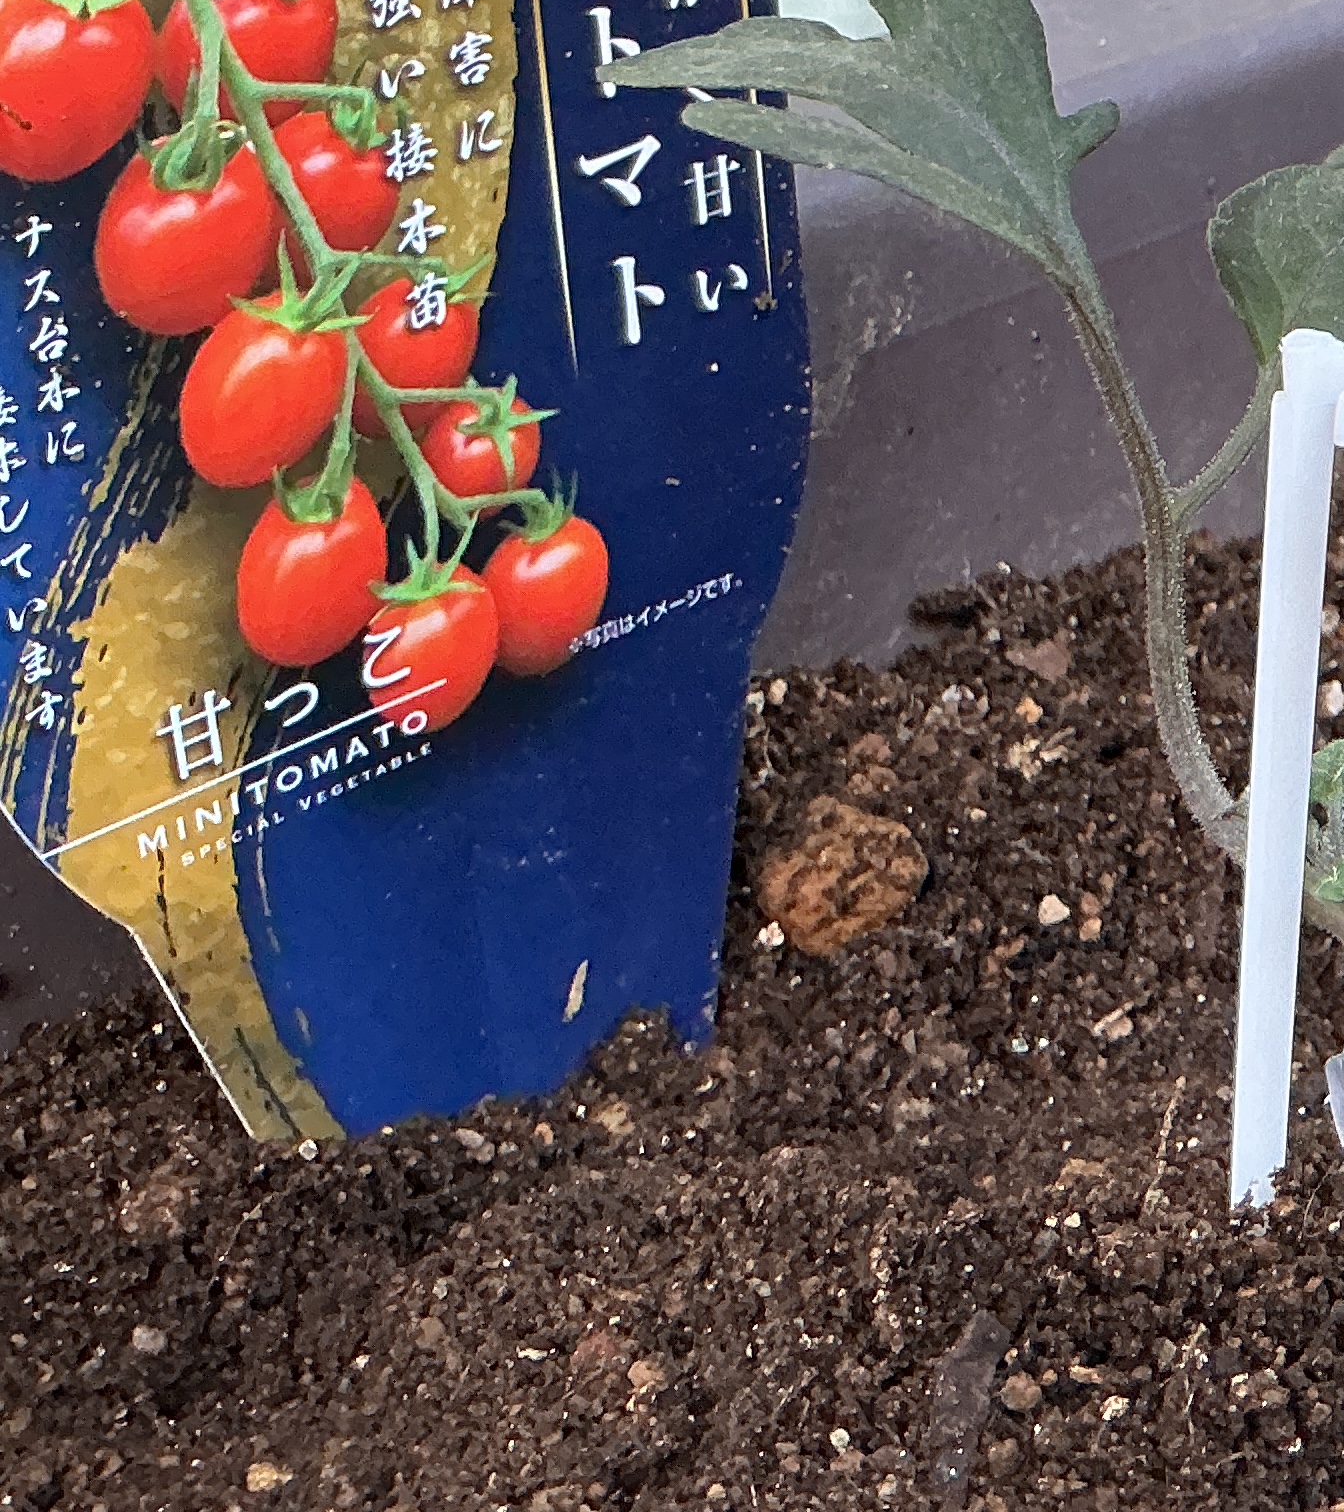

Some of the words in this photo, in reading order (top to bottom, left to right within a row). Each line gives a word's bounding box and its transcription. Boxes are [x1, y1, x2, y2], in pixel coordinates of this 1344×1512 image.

[15, 215, 85, 464] ナス台木に
[136, 710, 429, 859] MINITOMATO
[180, 809, 286, 868] SPECIAL
[298, 741, 433, 812] VEGETABLE
